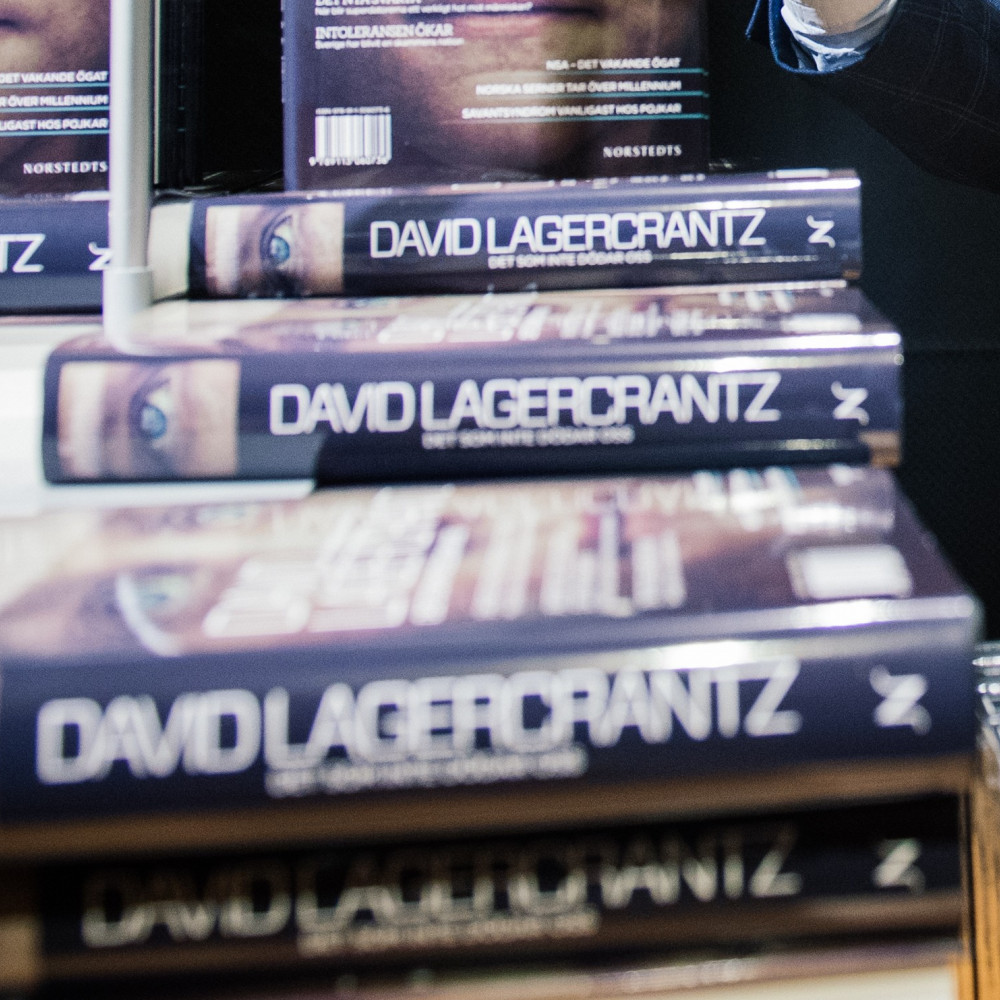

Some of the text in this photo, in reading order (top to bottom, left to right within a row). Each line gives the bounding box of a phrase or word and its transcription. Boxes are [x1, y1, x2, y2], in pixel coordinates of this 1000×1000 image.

[415, 21, 454, 38] ÖKAR
[22, 71, 75, 83] VAKANDE
[76, 69, 108, 81] ÖGAT
[8, 95, 38, 107] ÖVER
[39, 94, 108, 107] MILLENNIUM
[37, 119, 61, 130] HOS
[62, 117, 108, 129] POJKAR
[603, 145, 682, 158] NORSTEDTS
[23, 161, 108, 174] NORSTEDTS
[370, 218, 482, 259] DAVID
[487, 208, 767, 254] LAGERCRANTZ
[269, 381, 416, 436] DAVID
[420, 371, 782, 430] LAGERCRANTZ
[35, 689, 260, 786] DAVID
[264, 659, 801, 769] LAGERCRANTZ
